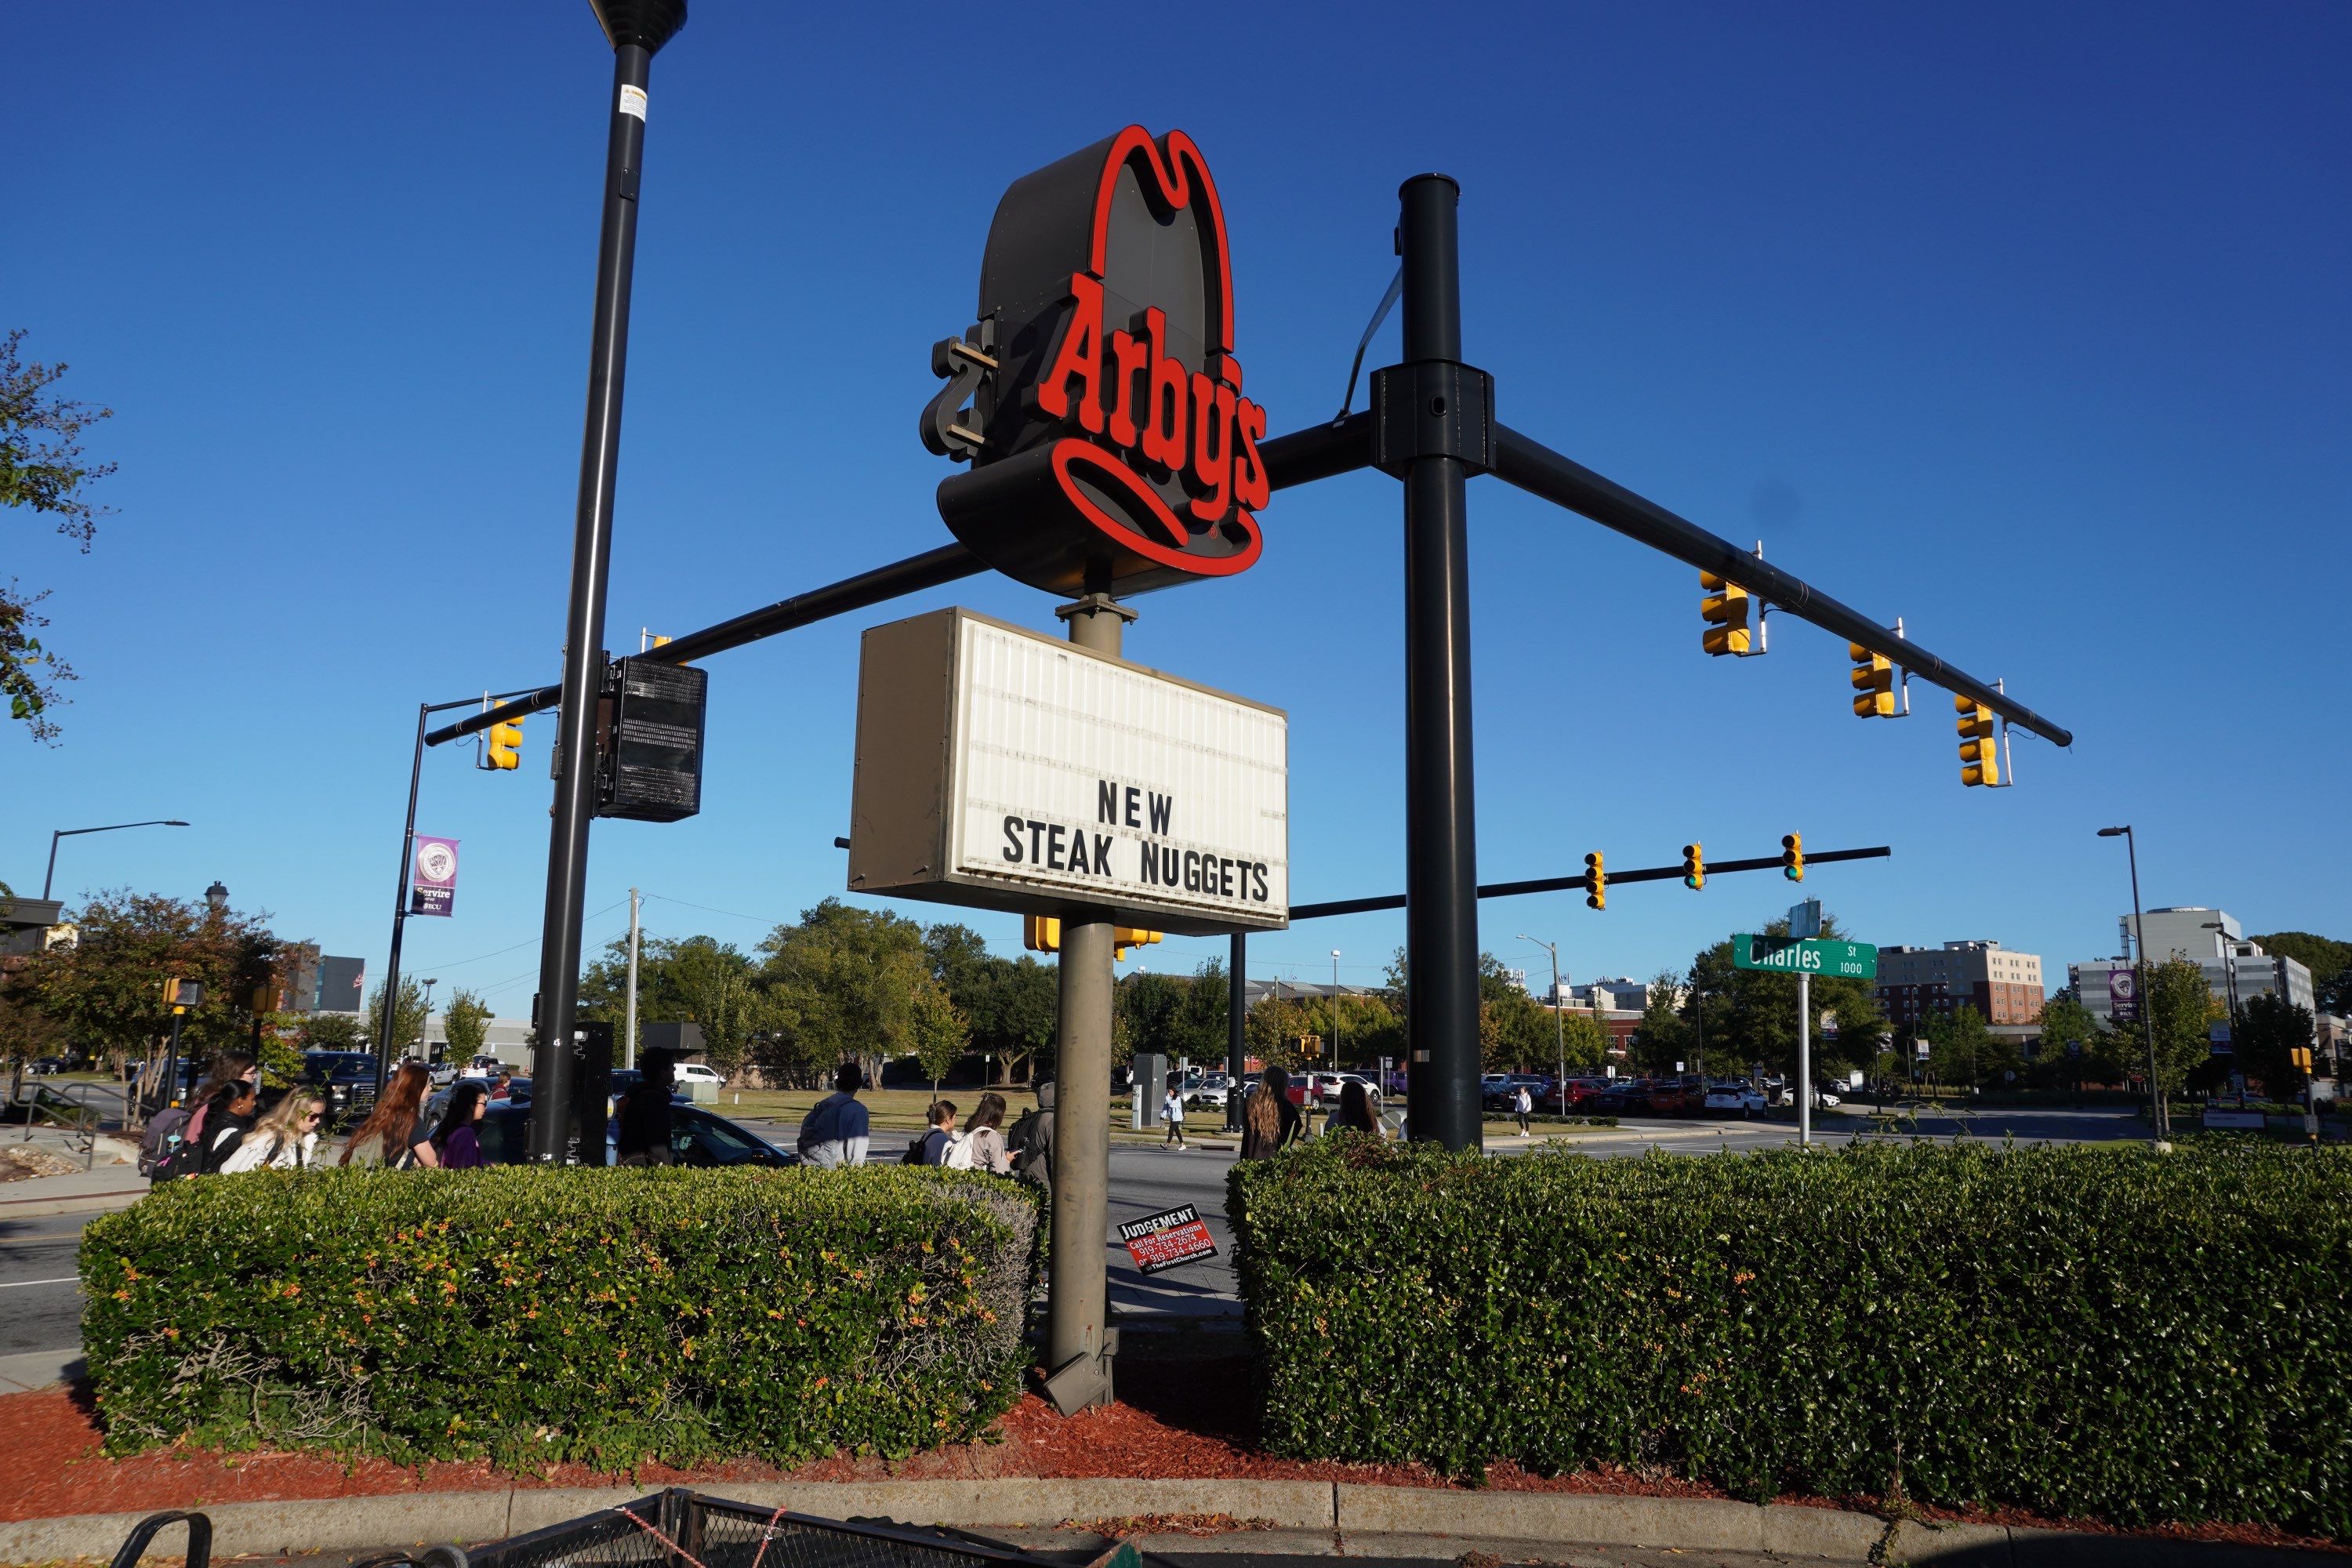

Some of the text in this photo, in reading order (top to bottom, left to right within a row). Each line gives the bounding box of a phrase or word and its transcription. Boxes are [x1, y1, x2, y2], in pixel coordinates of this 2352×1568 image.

[1037, 271, 1271, 521] Arby's
[1098, 779, 1172, 837] NEW
[1003, 815, 1268, 902] STEAK NUGGETS
[417, 887, 450, 898] Servire
[1750, 941, 1857, 969] Charles St
[1840, 962, 1863, 975] 1000
[1121, 1208, 1194, 1240] JUDGEMENT
[1129, 1240, 1144, 1250] Call
[1156, 1224, 1202, 1243] Reservations
[1138, 1233, 1197, 1257] 919-734-2674
[1149, 1239, 1210, 1263] 919-734-4660
[1152, 1249, 1212, 1269] TheFirstChurch.com
